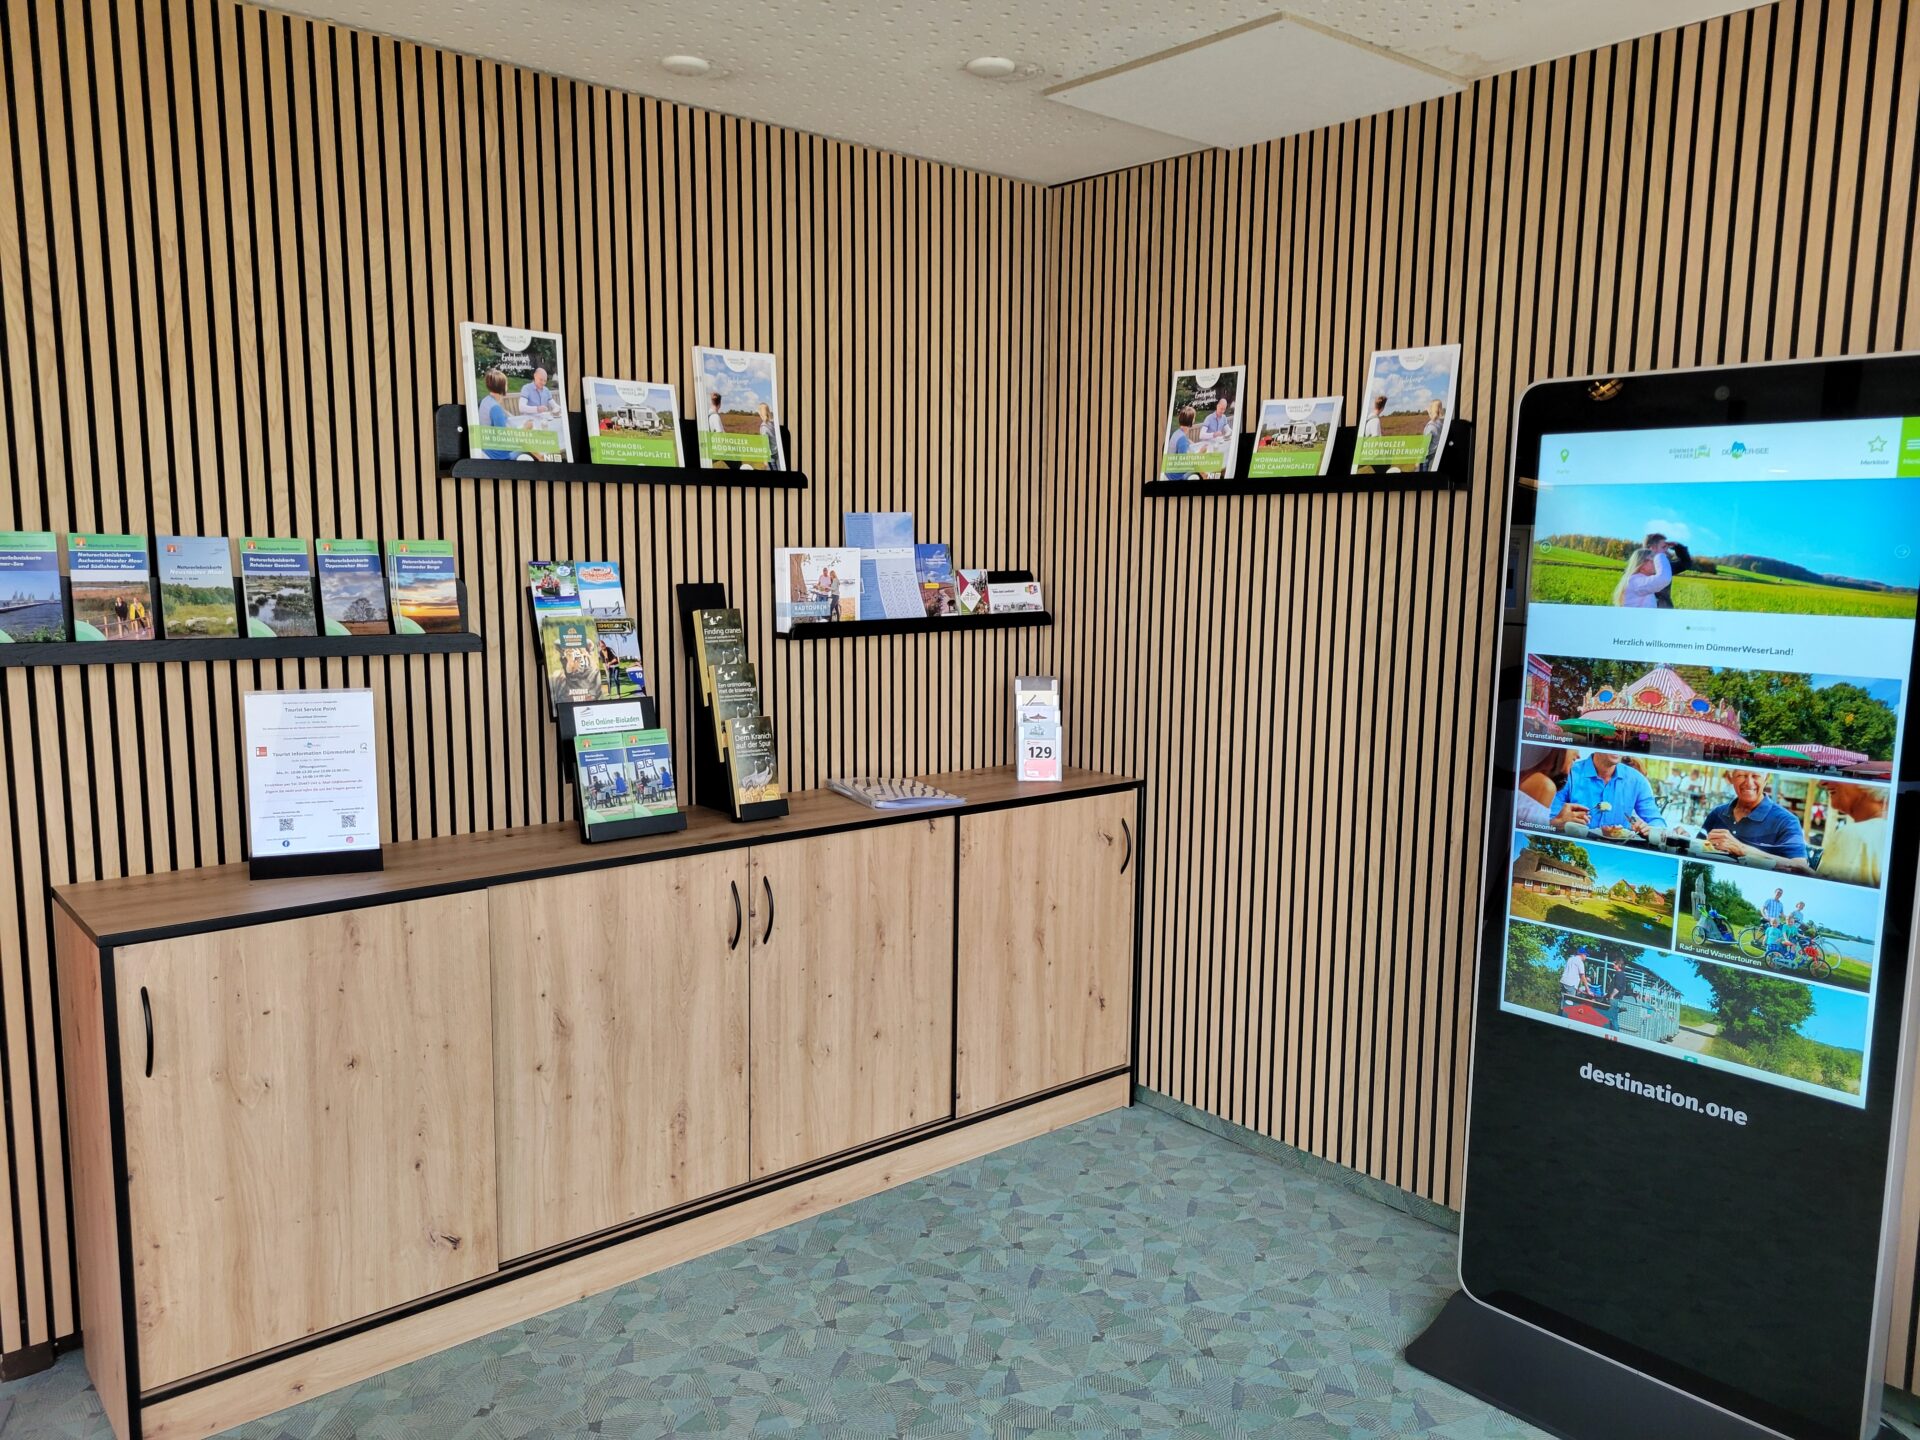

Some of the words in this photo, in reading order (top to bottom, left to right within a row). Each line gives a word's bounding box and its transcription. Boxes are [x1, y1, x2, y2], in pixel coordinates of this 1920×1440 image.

[711, 445, 768, 453] MOORNIEDERUNG
[1613, 637, 1644, 647] Herzlich
[1645, 639, 1693, 650] willkommen
[1695, 642, 1704, 650] im
[1706, 643, 1794, 656] DümmerWeserLand!
[581, 719, 595, 727] Dein
[1525, 731, 1573, 743] Veranstaltungen
[1028, 746, 1052, 758] 129
[1519, 820, 1556, 832] Gastronomie
[1572, 881, 1609, 894] Unterkünfte
[1679, 942, 1694, 951] Rad-
[1696, 946, 1709, 956] und
[1710, 949, 1762, 967] Wandertouren
[1579, 1062, 1748, 1126] destination.one
